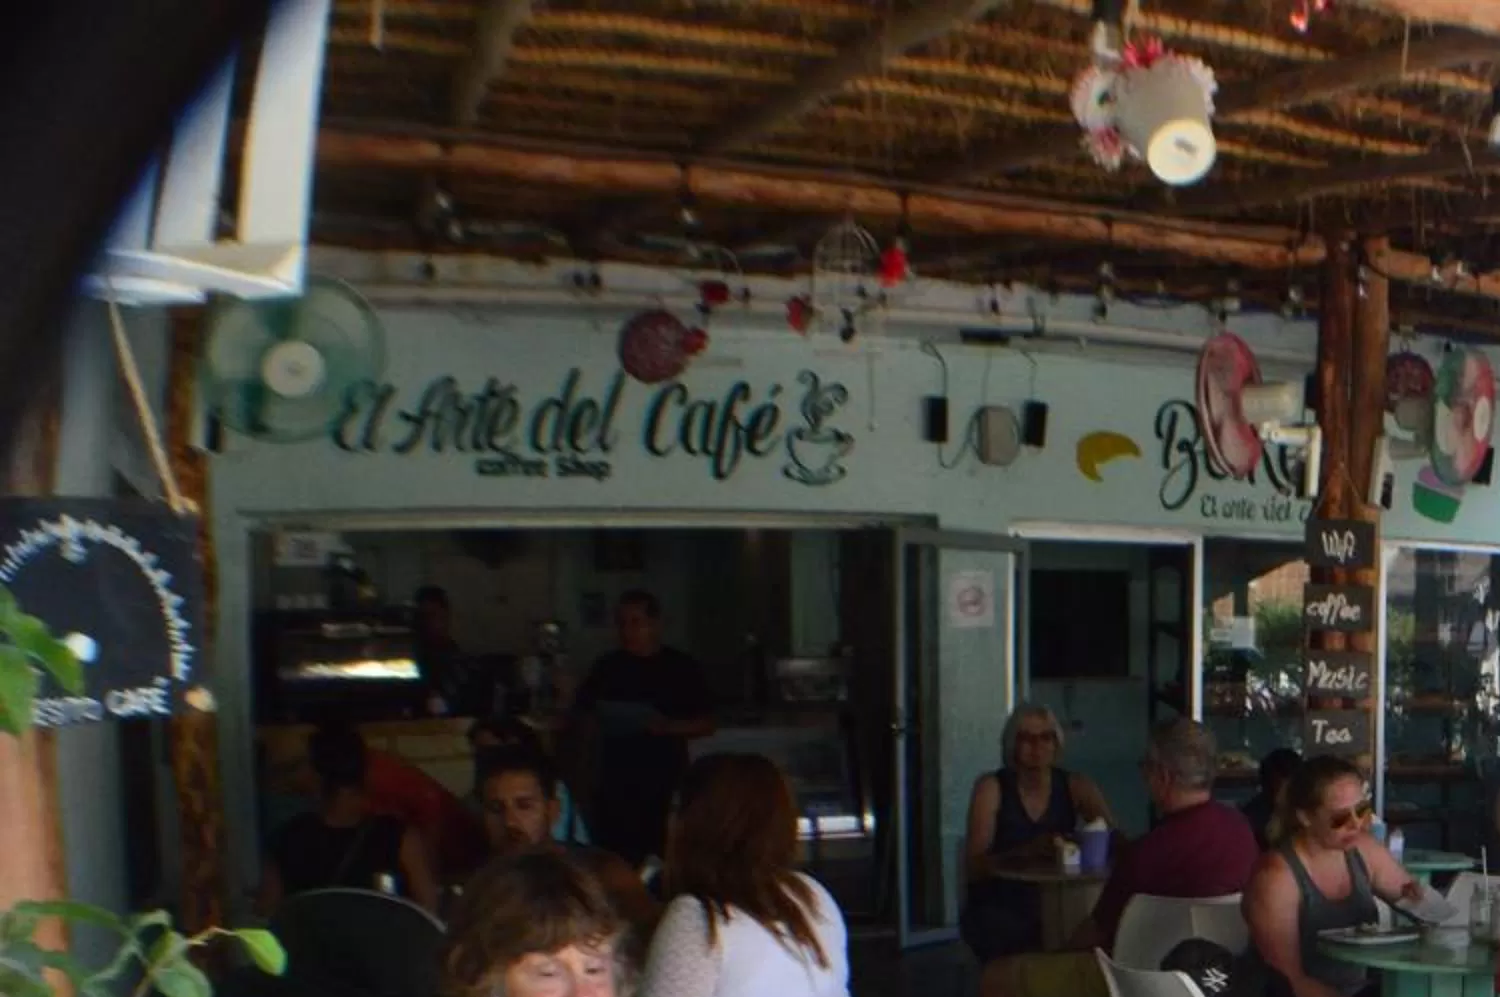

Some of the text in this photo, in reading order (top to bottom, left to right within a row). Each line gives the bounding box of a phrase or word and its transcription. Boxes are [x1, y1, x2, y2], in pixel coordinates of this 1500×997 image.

[326, 377, 396, 452] El
[529, 366, 628, 453] del
[643, 380, 783, 480] Café
[1306, 659, 1369, 691] Music
[1311, 719, 1354, 746] Tea
